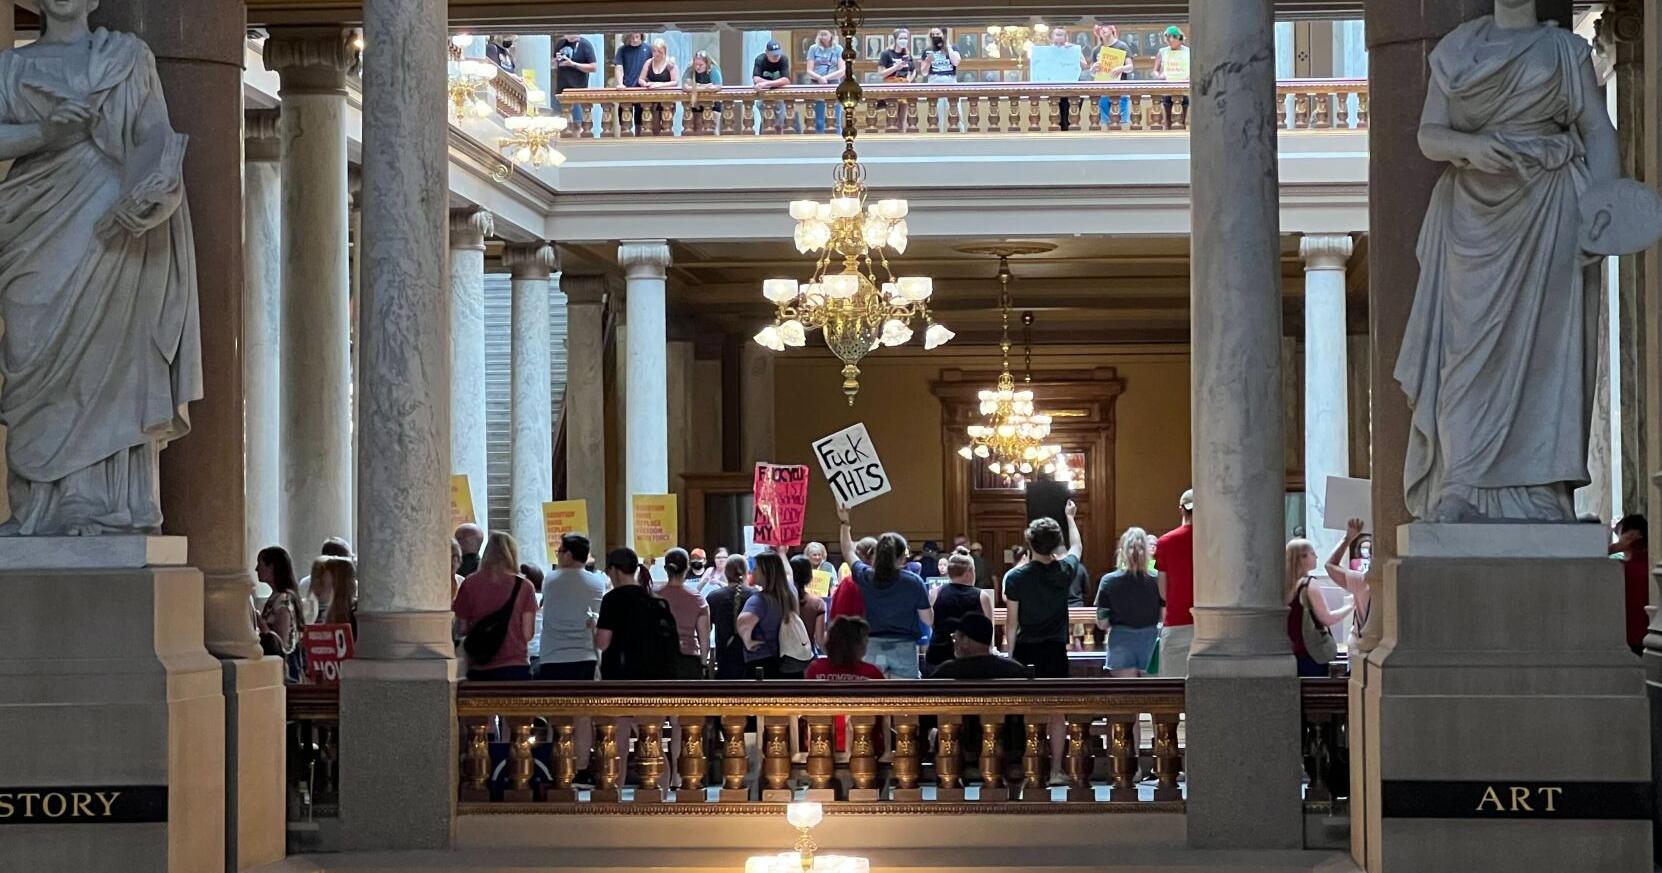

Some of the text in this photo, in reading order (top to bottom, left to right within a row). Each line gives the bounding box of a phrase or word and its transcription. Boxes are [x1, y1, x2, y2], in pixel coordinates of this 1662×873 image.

[828, 463, 884, 501] THIS
[0, 792, 121, 817] STORY
[1475, 786, 1562, 811] ART
